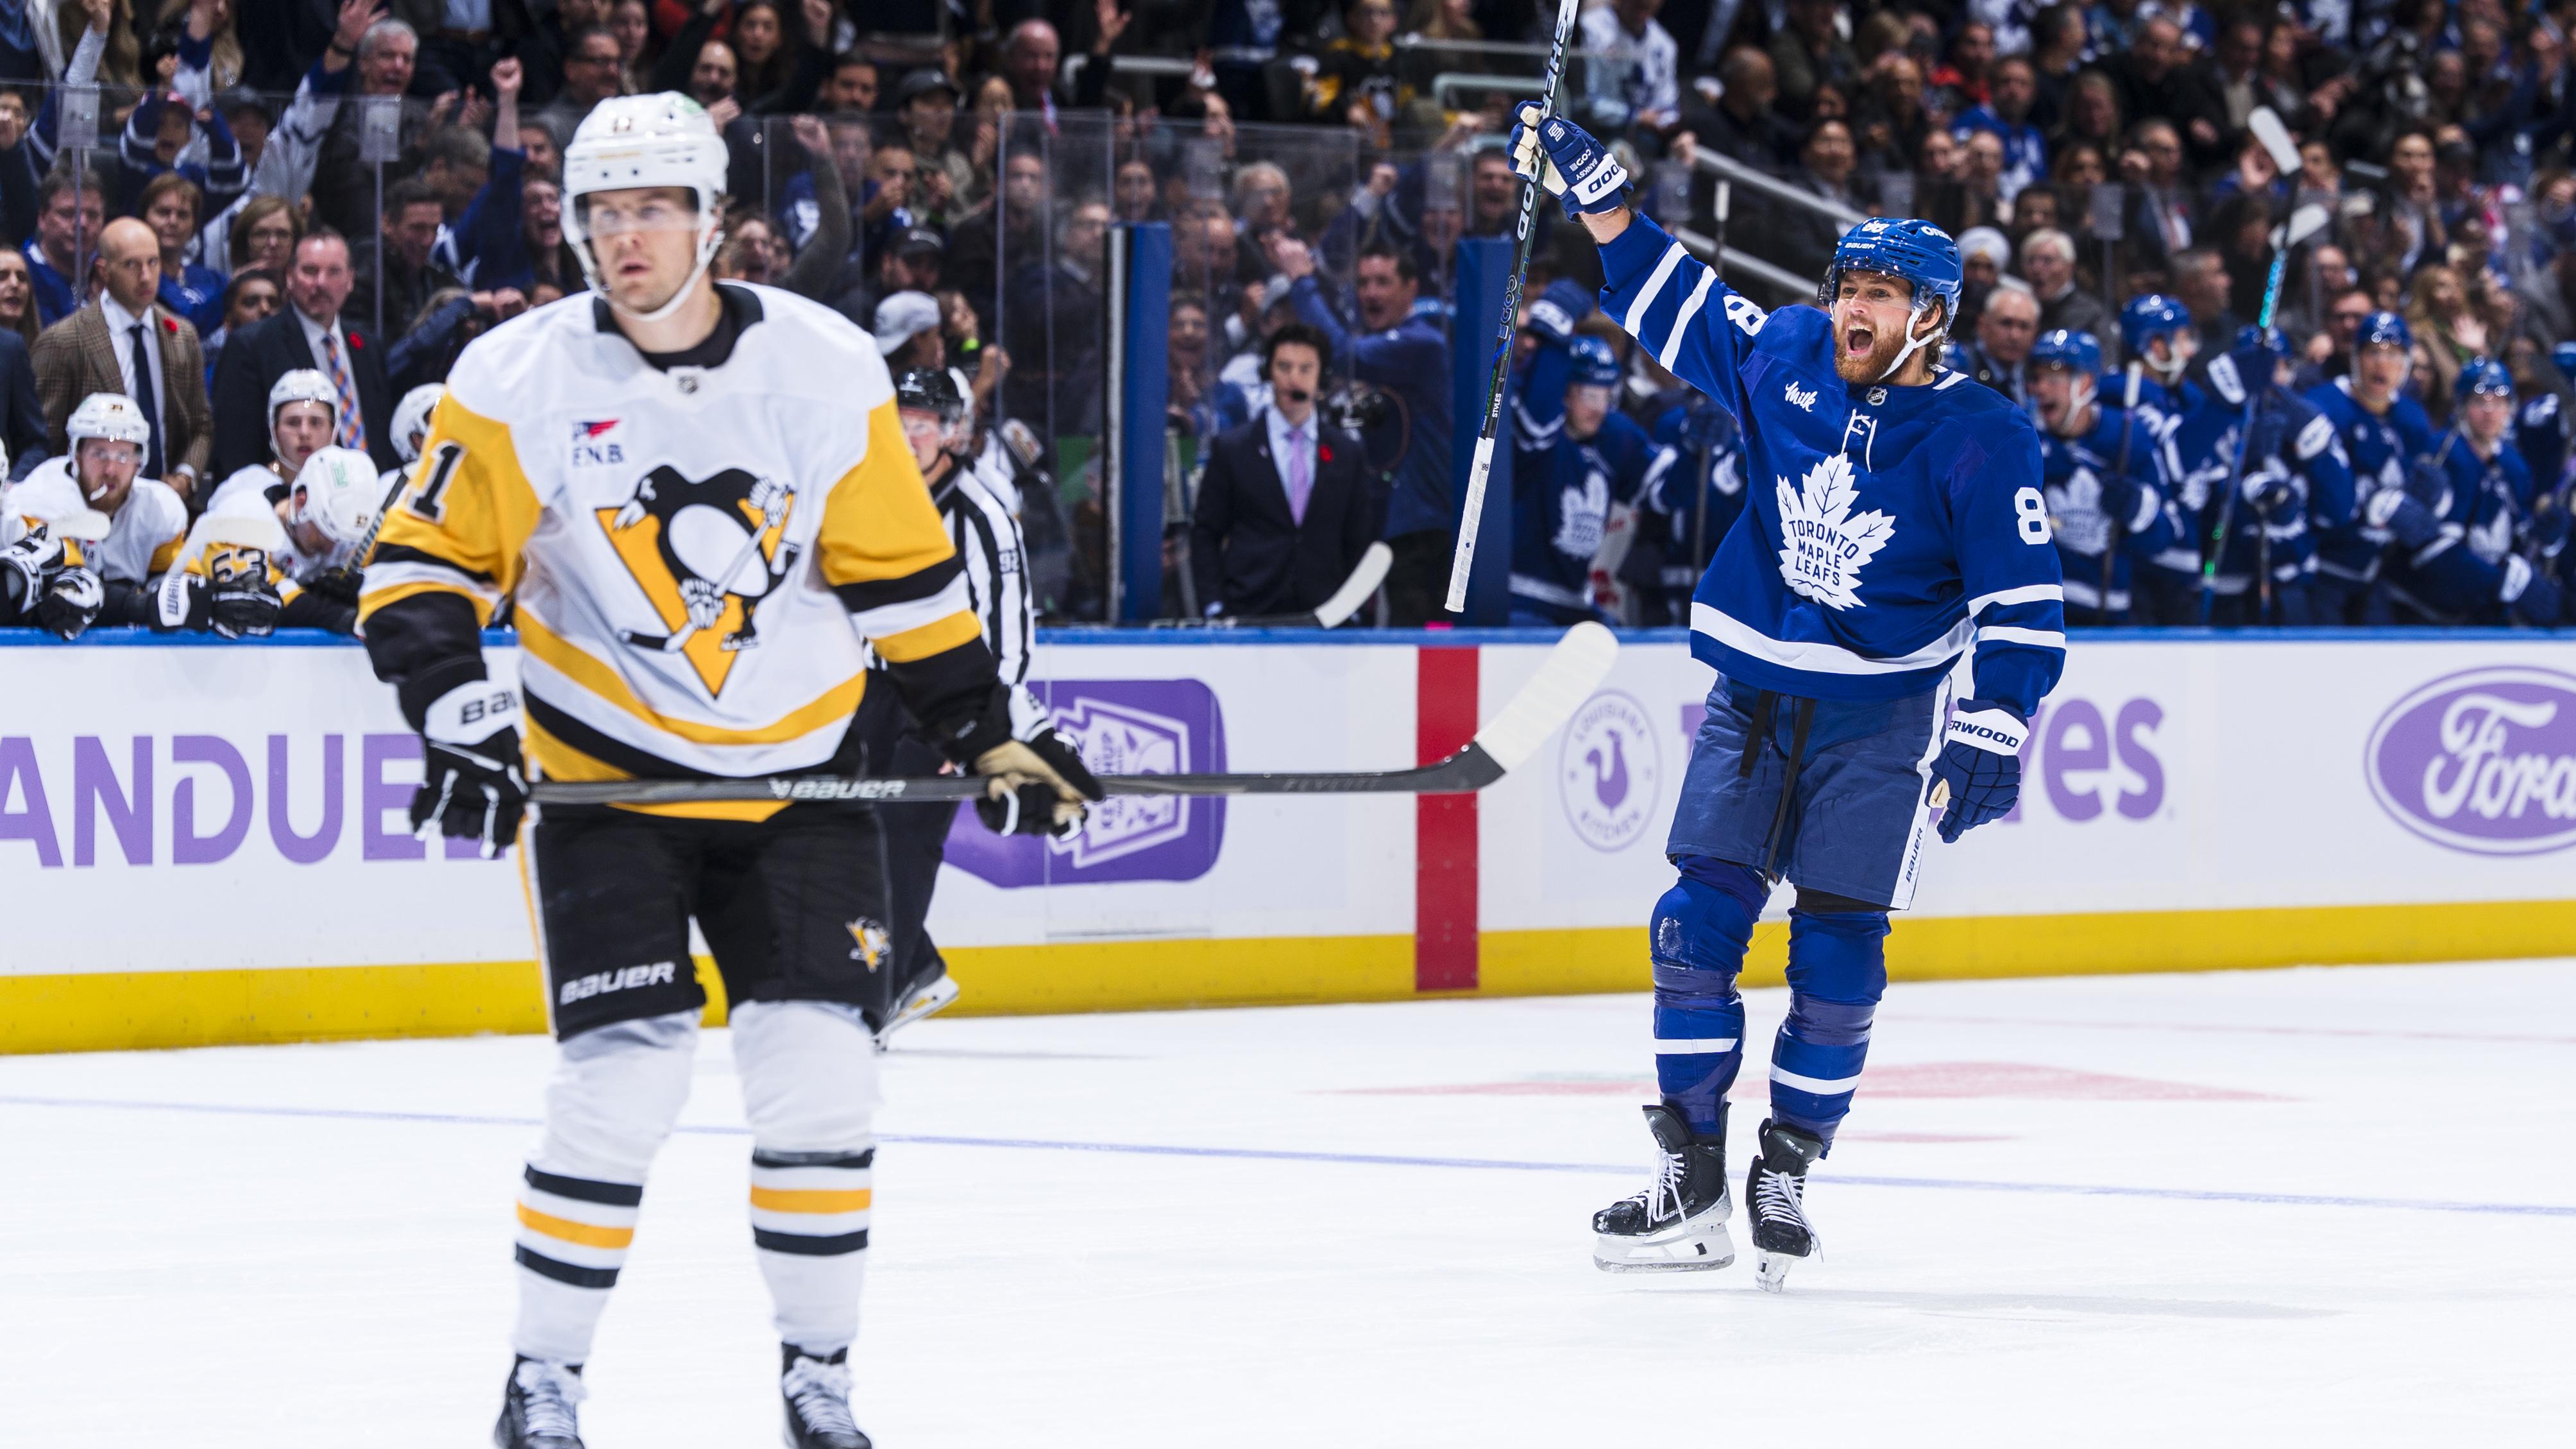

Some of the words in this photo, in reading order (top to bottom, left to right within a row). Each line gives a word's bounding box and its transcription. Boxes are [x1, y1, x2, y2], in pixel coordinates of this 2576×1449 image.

[1517, 6, 1569, 241] SHEROOD
[1576, 158, 1598, 181] BANKSY
[1498, 275, 1518, 339] CODE
[1492, 393, 1502, 418] STYLES
[405, 439, 470, 525] 1
[1788, 520, 1860, 560] TORONTO
[1797, 538, 1842, 570] MAPLE
[1795, 555, 1840, 586] LEAFS
[0, 735, 507, 868] ANDUE
[790, 779, 907, 799] BAUER
[1906, 827, 1922, 883] BAUER
[559, 961, 676, 1006] BAUER
